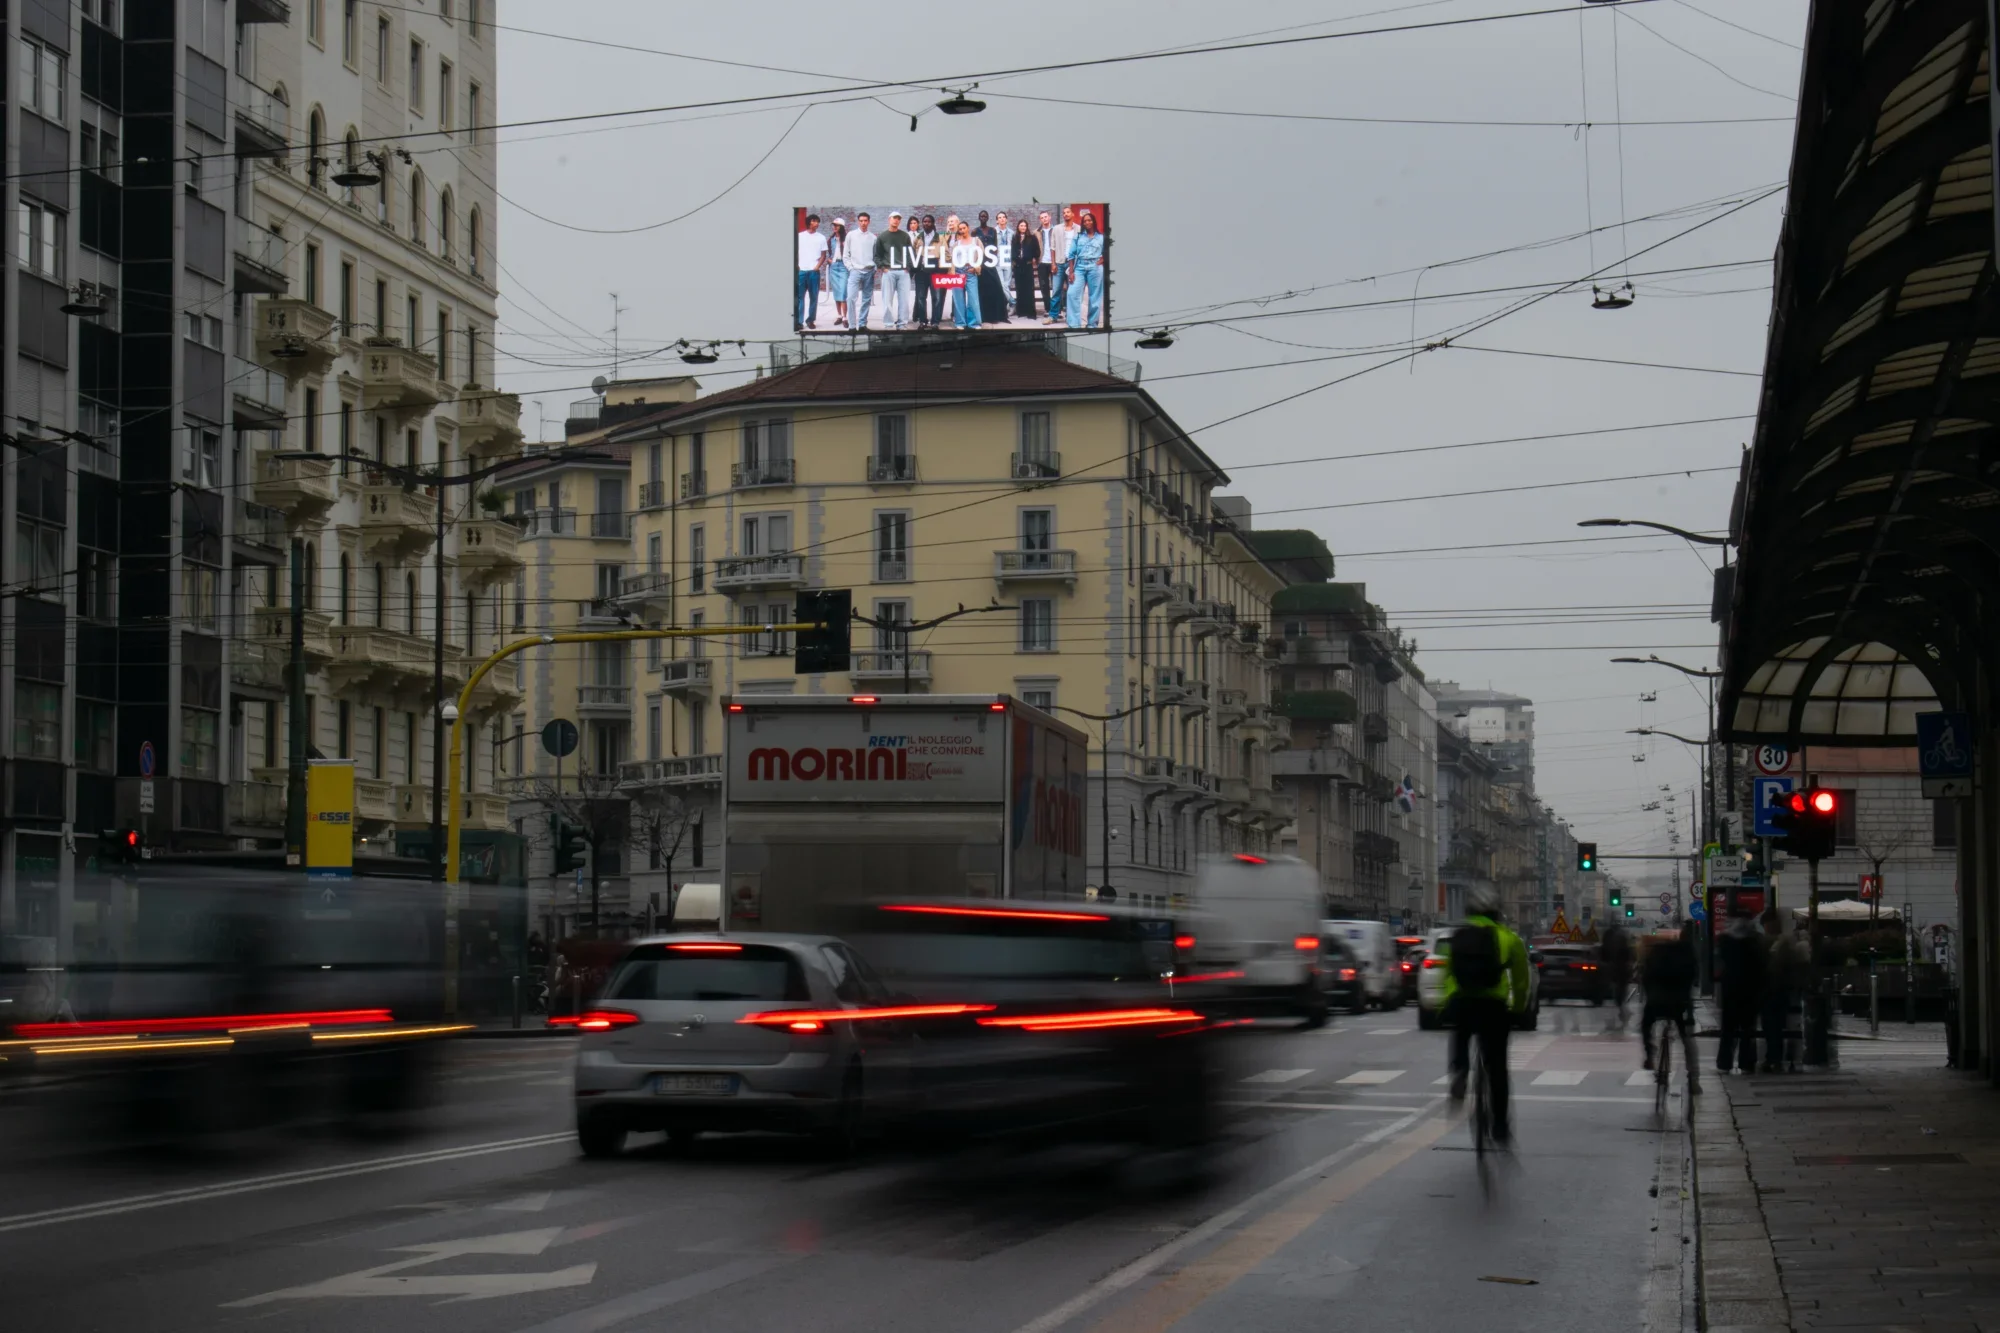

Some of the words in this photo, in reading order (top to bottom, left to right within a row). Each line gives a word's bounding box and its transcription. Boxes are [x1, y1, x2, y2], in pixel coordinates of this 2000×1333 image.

[889, 246, 936, 268] LIVE
[939, 244, 1012, 268] LOOSE
[869, 735, 906, 747] RENT
[907, 735, 916, 744] IL
[918, 735, 973, 745] NOLEGGIO
[907, 746, 929, 755] CHE
[931, 746, 985, 755] CONVIENE
[1763, 748, 1784, 765] 30
[748, 747, 907, 781] MORINI
